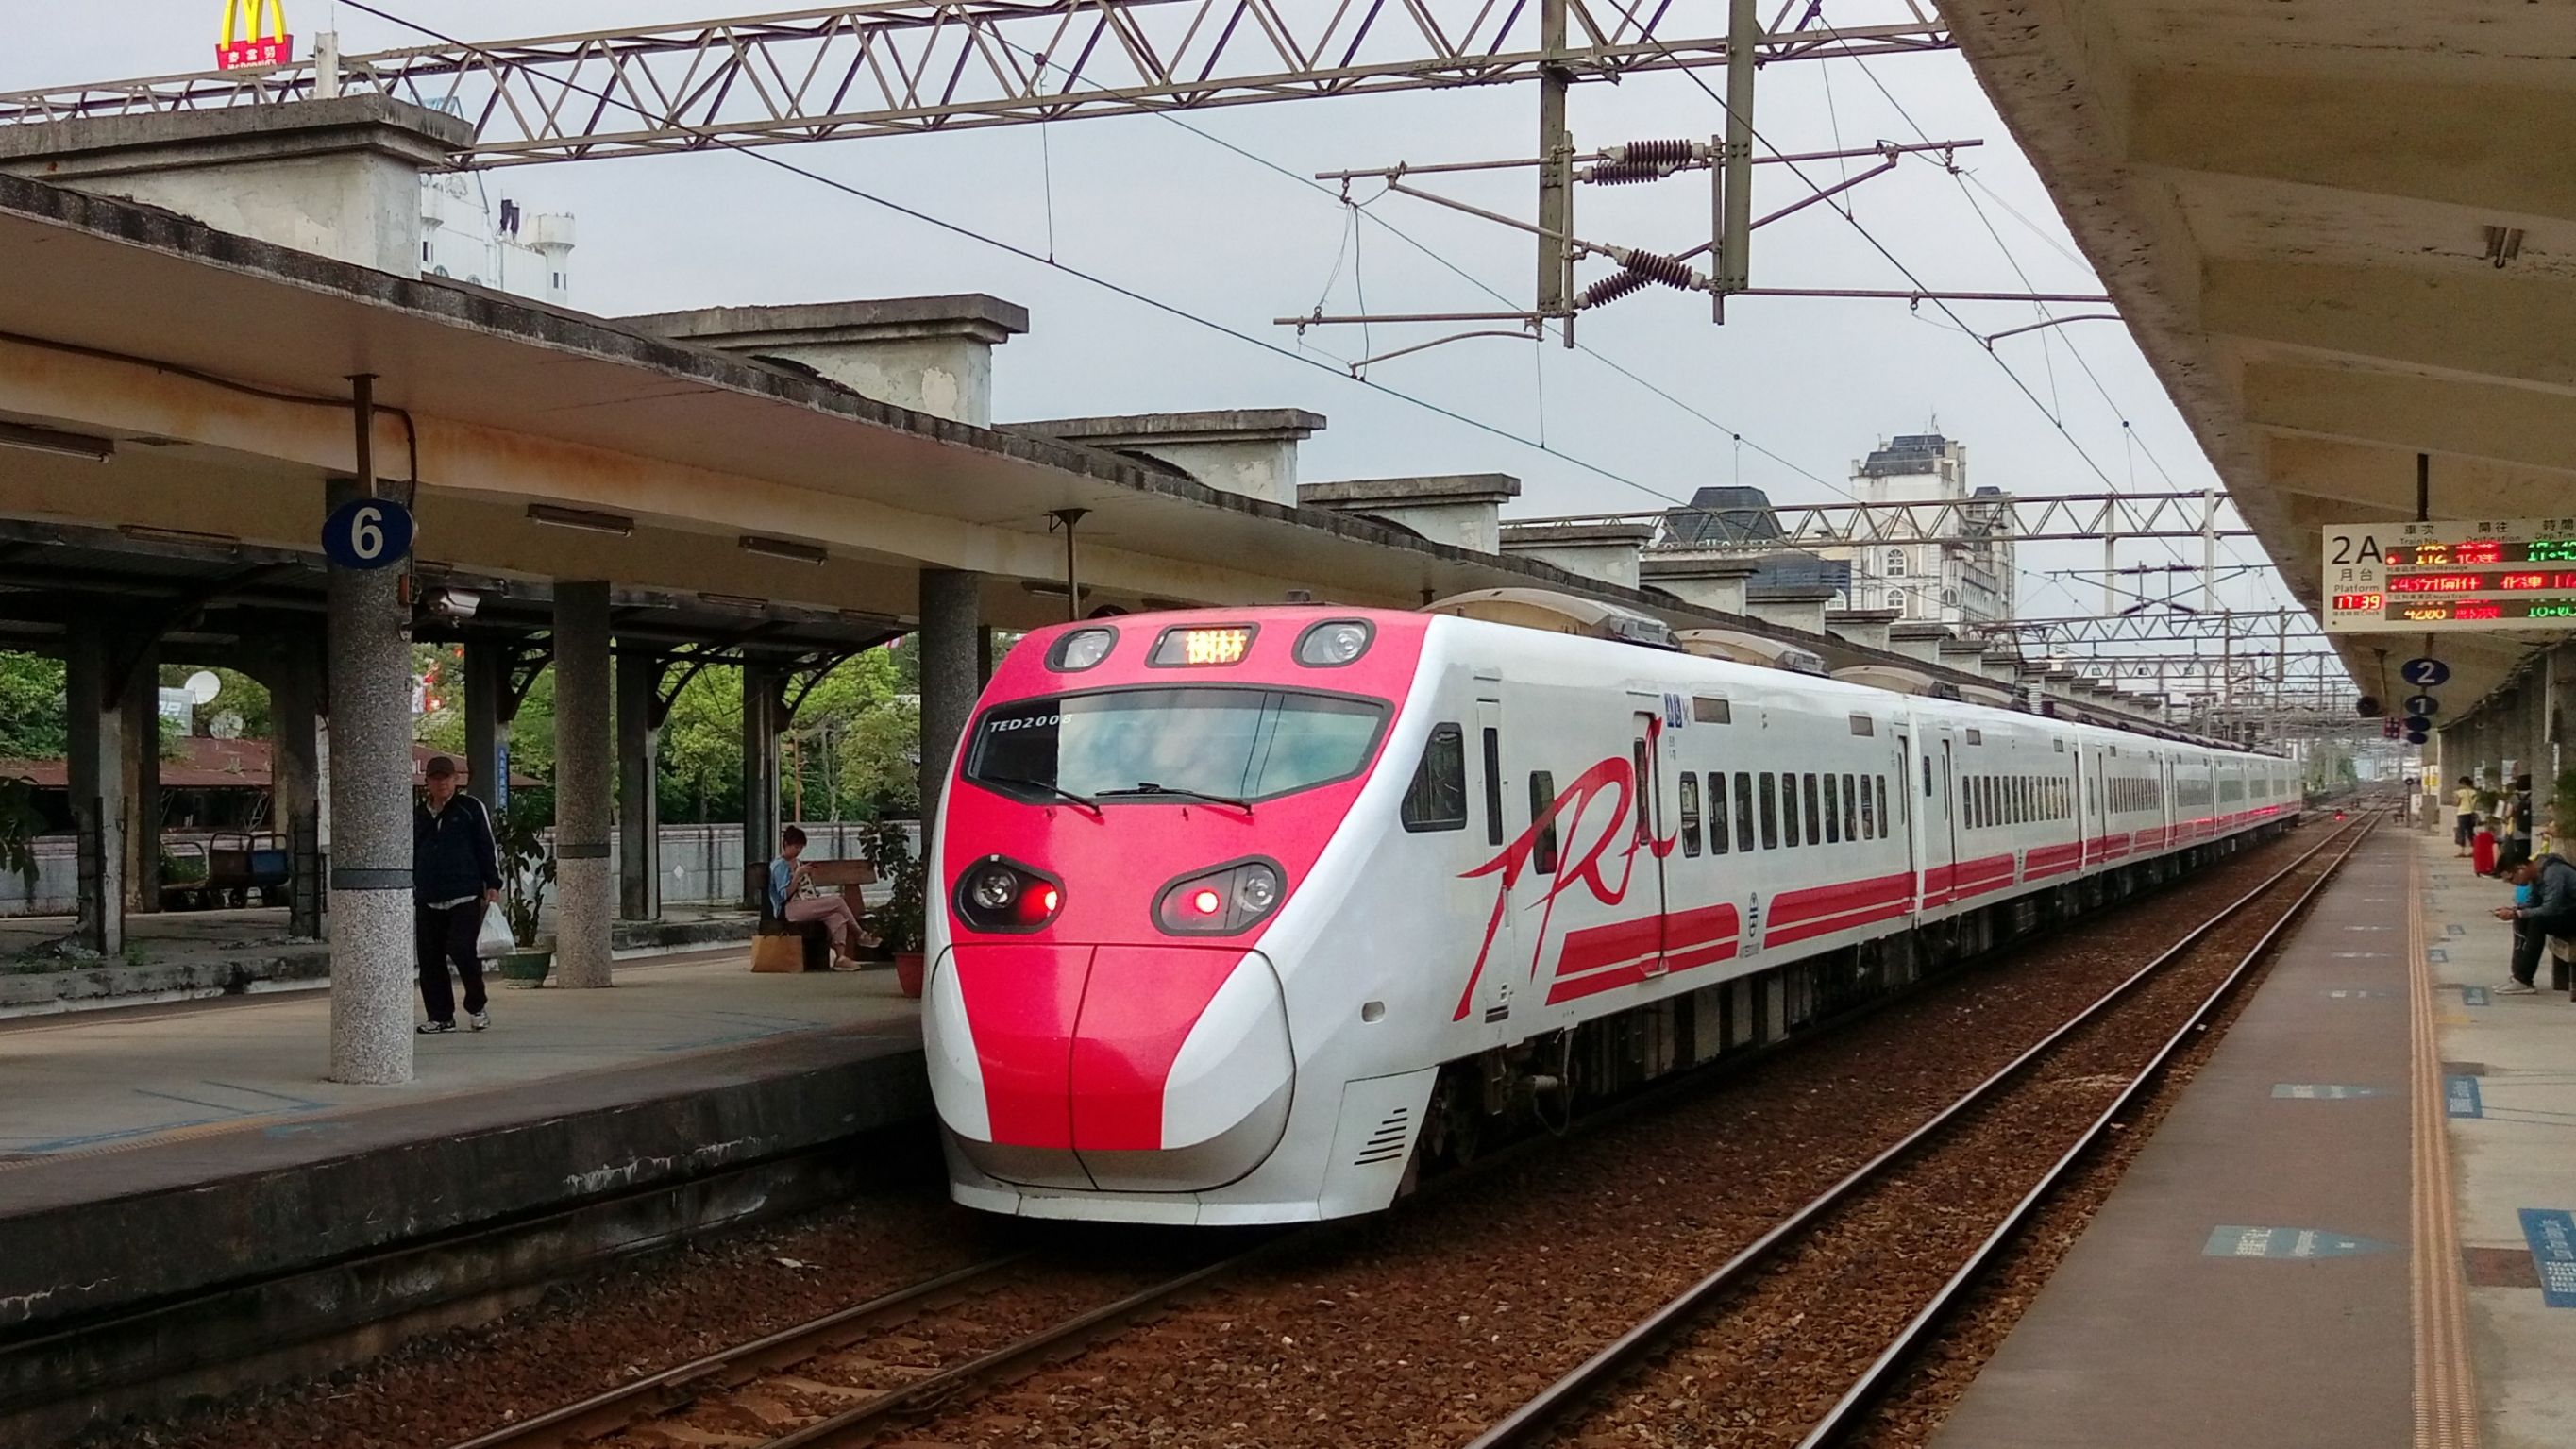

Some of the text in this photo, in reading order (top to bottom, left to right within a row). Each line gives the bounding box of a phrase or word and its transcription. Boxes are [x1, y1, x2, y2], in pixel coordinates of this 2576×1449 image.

[352, 507, 383, 559] 6
[2332, 535, 2382, 564] 2A
[2341, 568, 2373, 581] 月台
[2417, 662, 2435, 683] 2
[2415, 699, 2427, 714] 1
[990, 714, 1073, 733] TED2008
